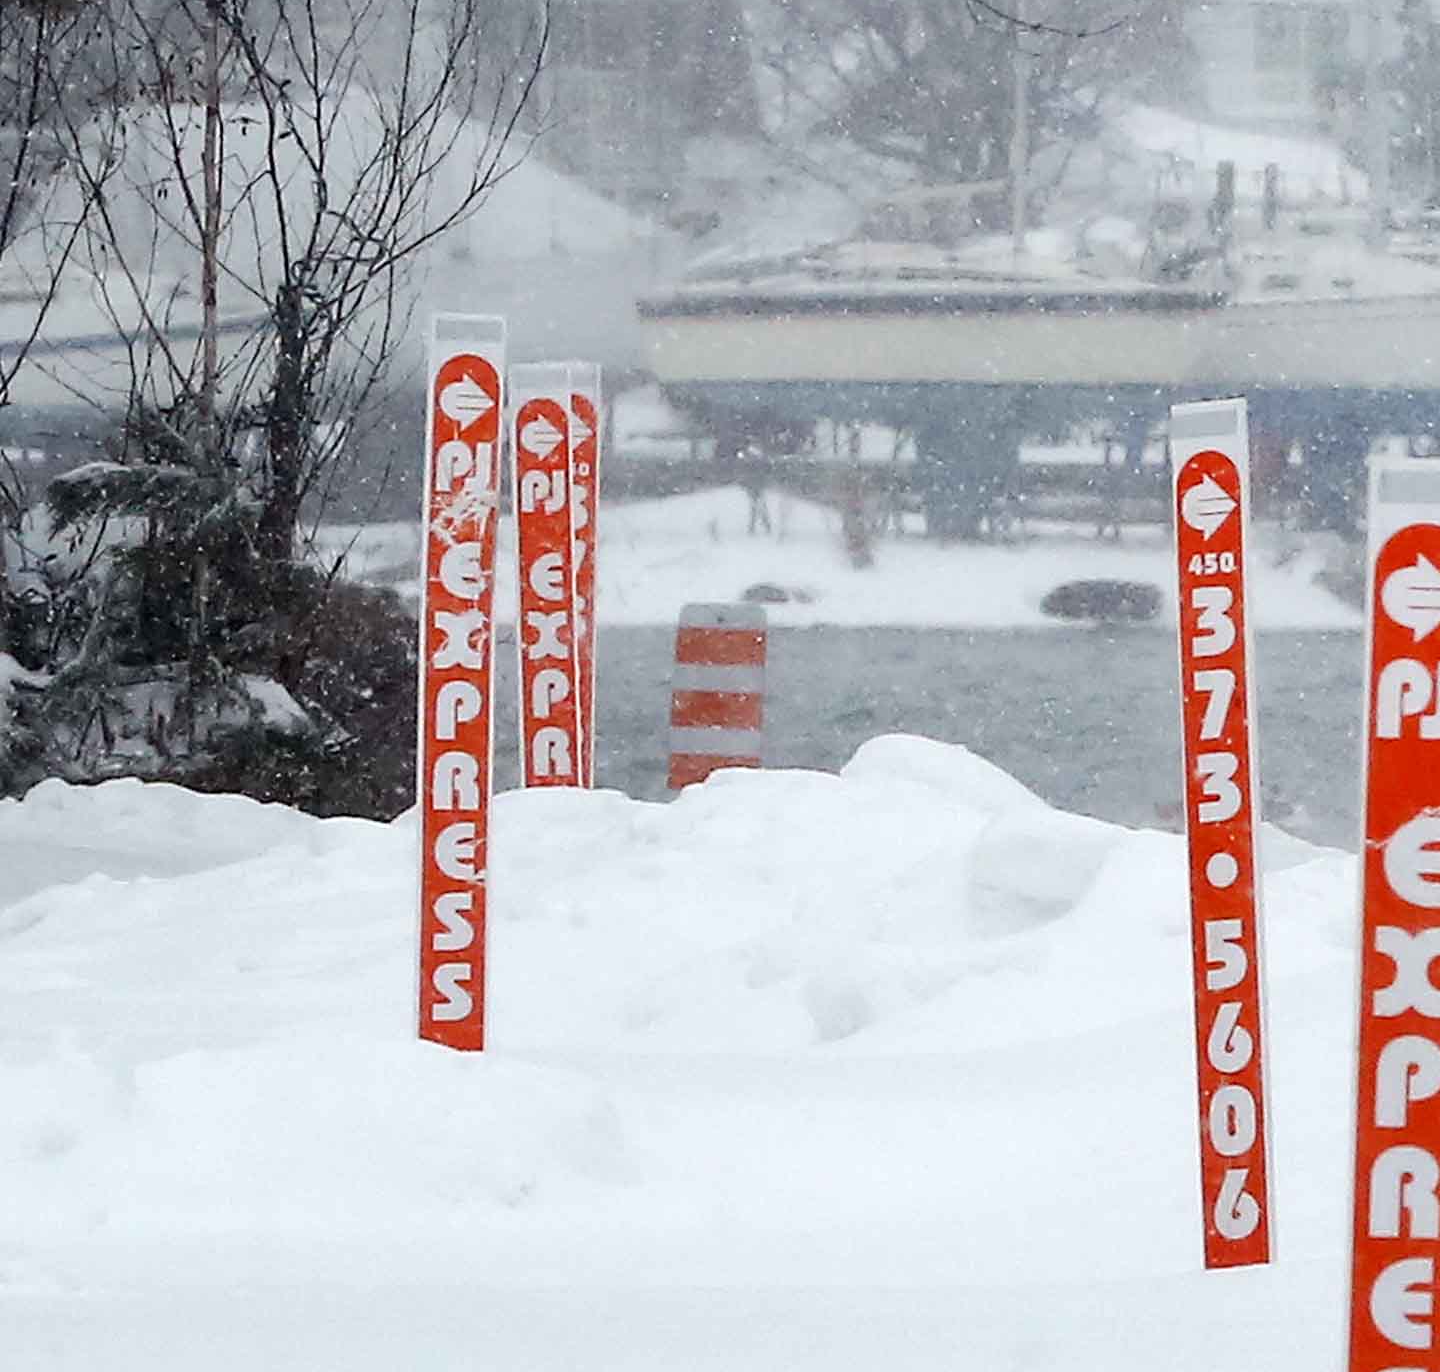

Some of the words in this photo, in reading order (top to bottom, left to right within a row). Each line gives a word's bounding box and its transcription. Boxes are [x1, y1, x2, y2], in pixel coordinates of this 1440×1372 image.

[435, 440, 493, 501] PJ
[520, 469, 567, 514] PJ
[1188, 551, 1236, 576] 450
[527, 552, 572, 777] EXPR
[431, 541, 486, 1022] EXPRESS
